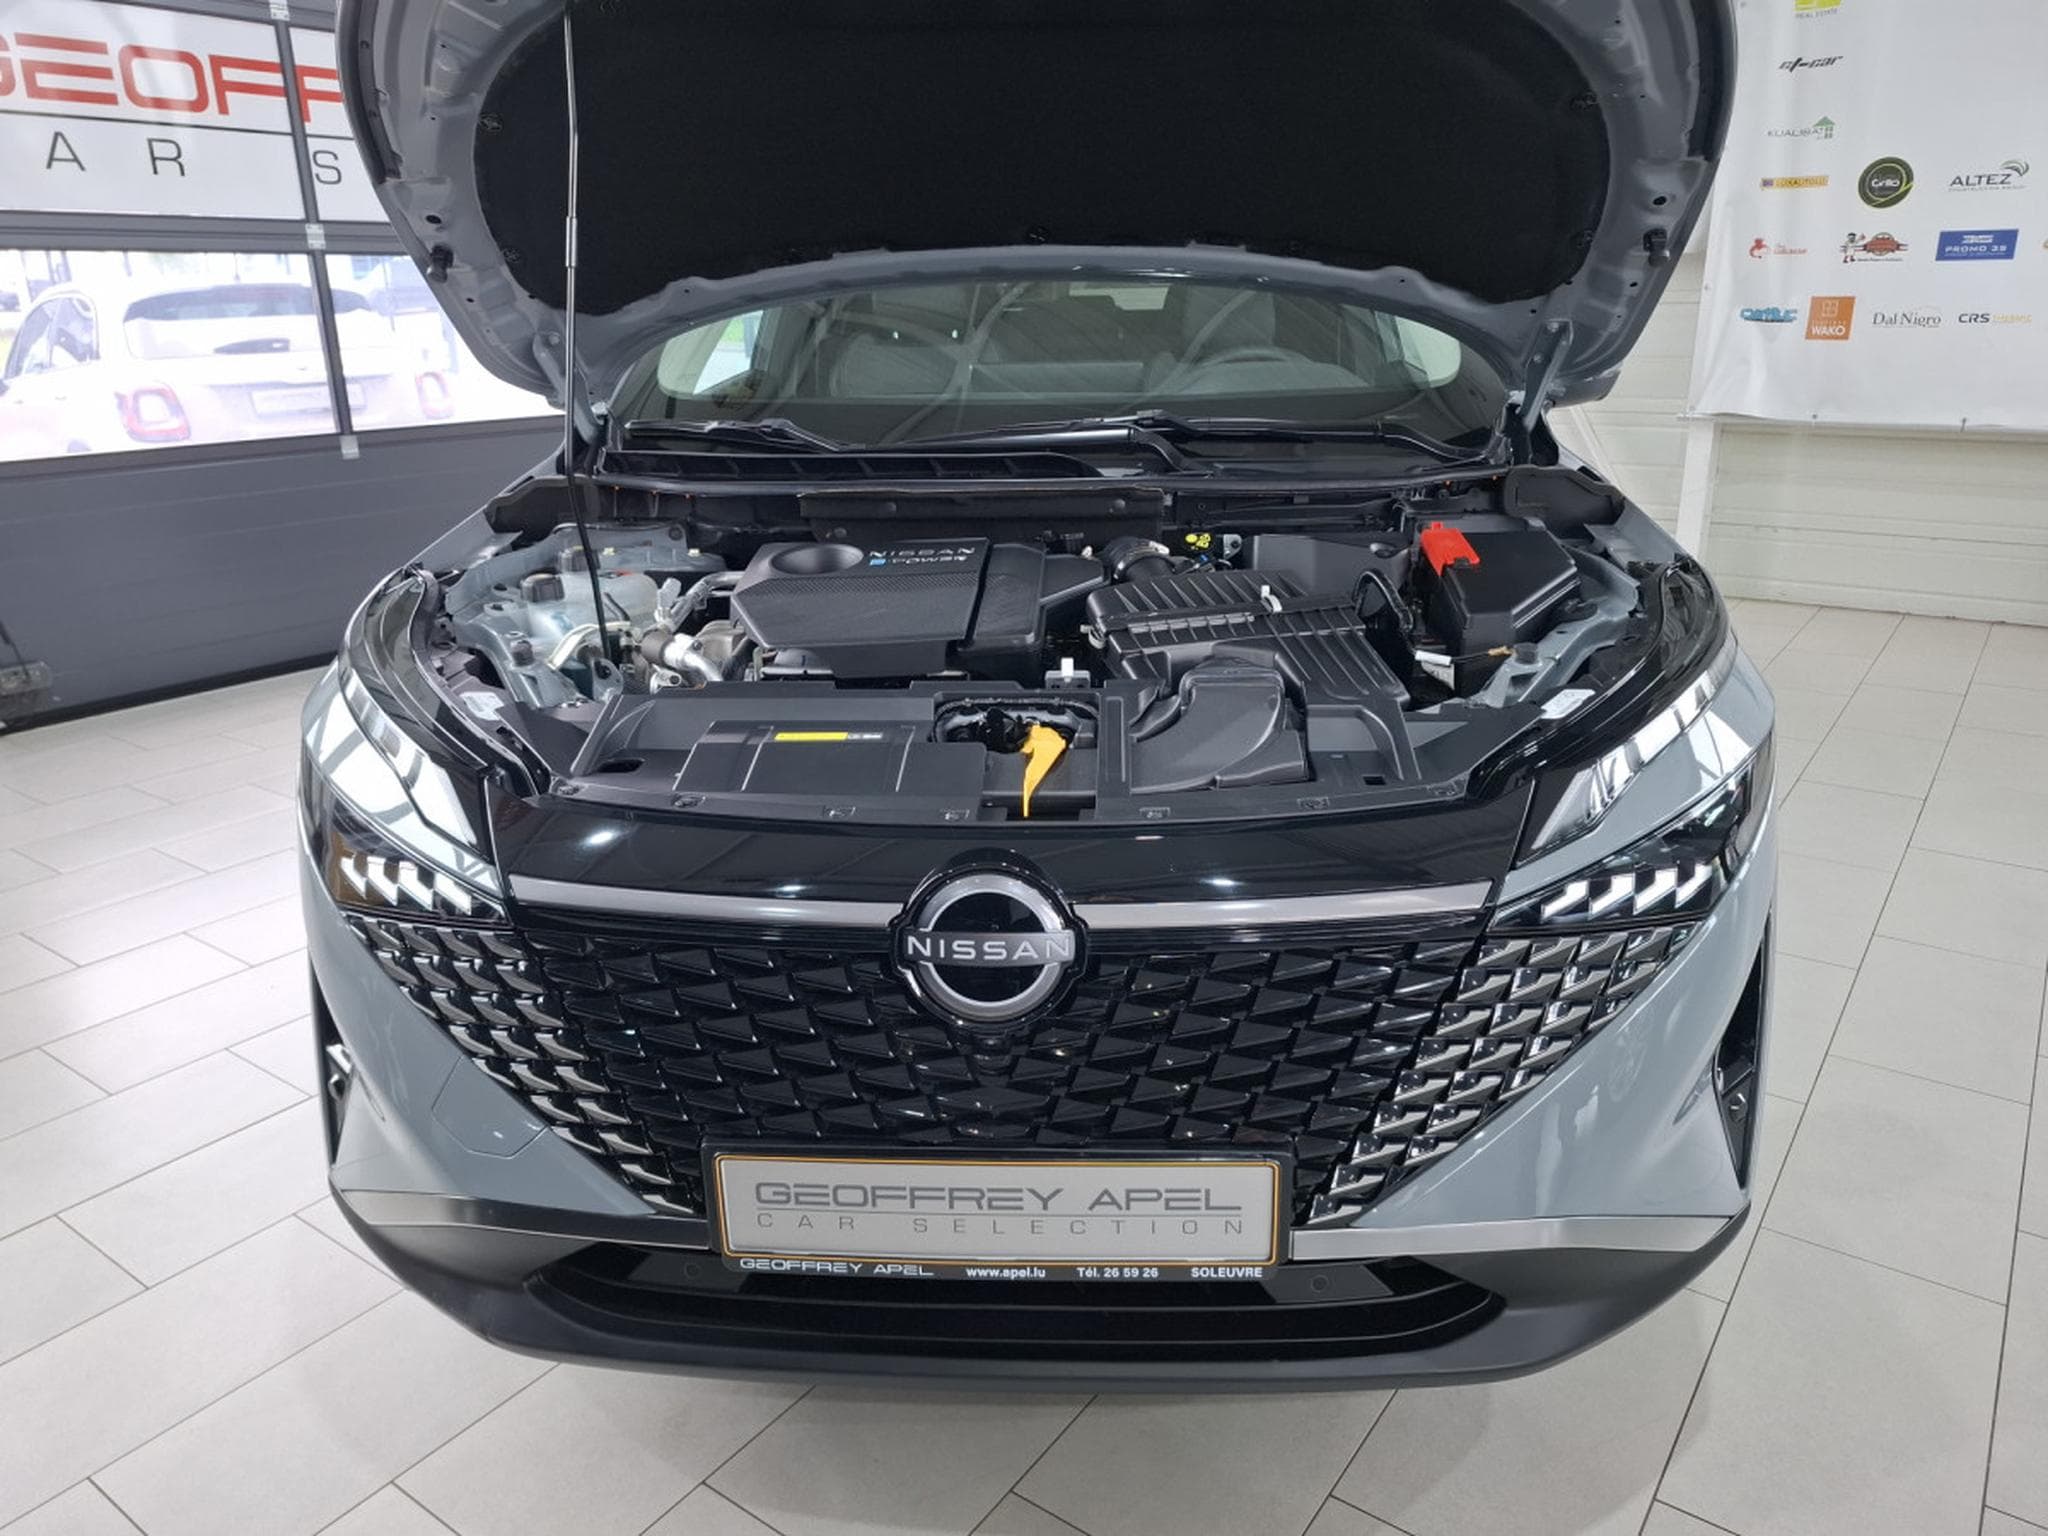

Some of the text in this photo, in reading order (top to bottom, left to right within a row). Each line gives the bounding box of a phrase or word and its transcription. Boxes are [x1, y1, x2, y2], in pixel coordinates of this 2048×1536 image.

[1950, 173, 2012, 187] ALTEZ
[1944, 244, 1987, 253] PROMO
[1872, 312, 1942, 328] Dal Nigro
[1958, 312, 1991, 324] CRS
[869, 547, 976, 558] NISSAN
[907, 935, 1070, 961] NISSAN
[755, 1181, 1243, 1211] GEOFFREY APEL
[756, 1212, 1243, 1236] CAR SELECTION
[739, 1257, 1263, 1280] GEOFFREY APEL www.apel.lu Tél. 26 59 26 SOLEUVRE
